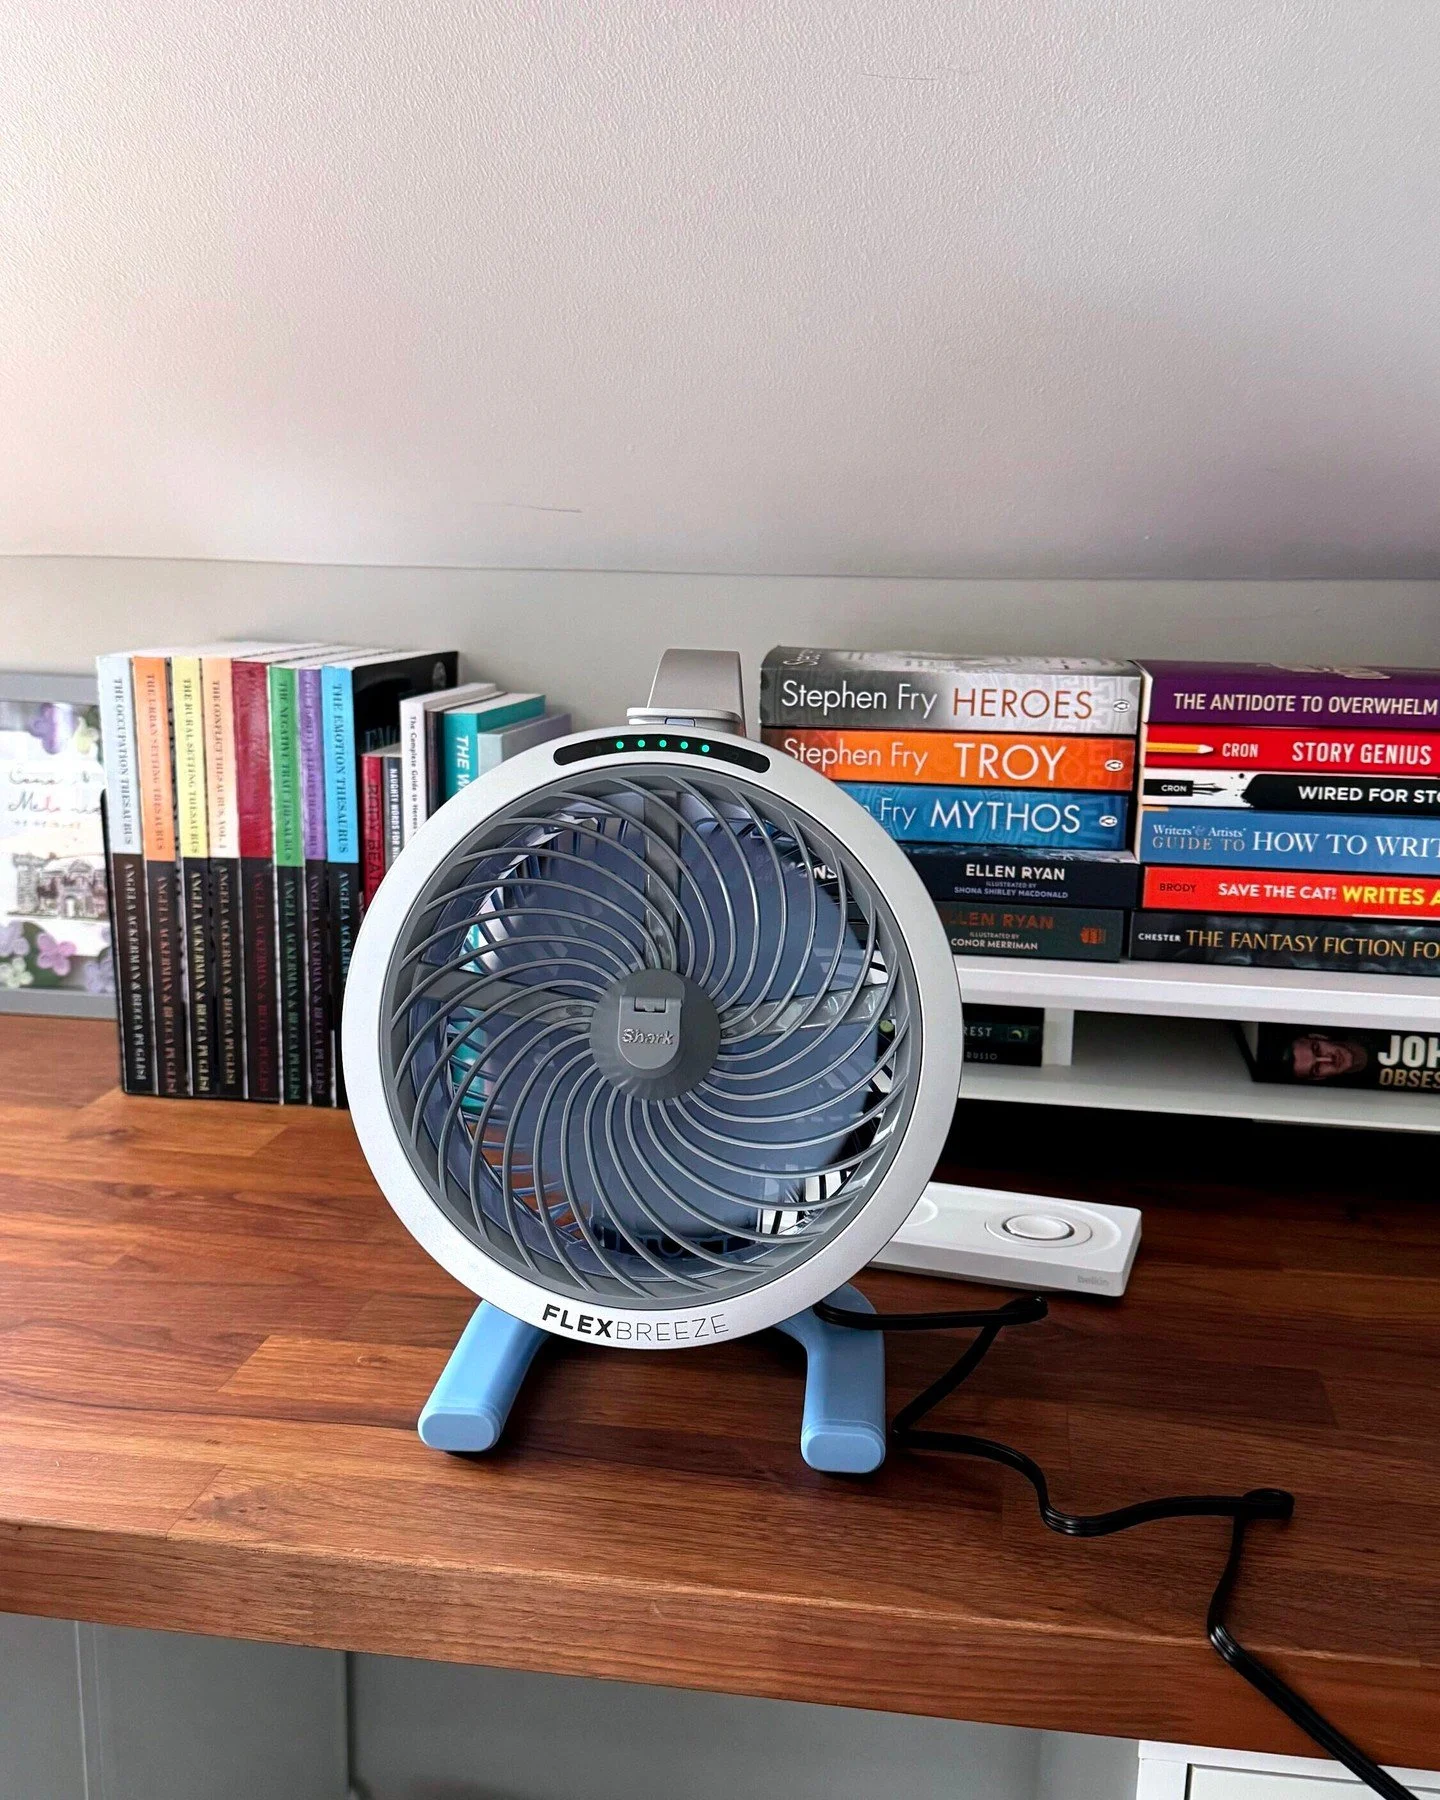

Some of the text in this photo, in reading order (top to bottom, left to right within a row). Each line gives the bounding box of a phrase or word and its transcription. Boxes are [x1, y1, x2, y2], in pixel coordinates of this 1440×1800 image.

[213, 681, 221, 701] THE
[279, 681, 288, 700] THE
[782, 680, 1092, 719] Stephen Fry HEROES
[1174, 693, 1438, 716] THE ANTIDOTE TO OVERWHELM
[214, 704, 223, 754] CONFLICT
[280, 707, 289, 758] NEGATIVE
[114, 678, 133, 845] THE OCCUPATION THESAURUS
[147, 674, 155, 695] THE
[153, 788, 163, 850] THESAURUS
[183, 678, 199, 853] THE RURAL SETTING THESAURUS
[409, 733, 418, 767] Complete
[456, 735, 469, 769] THE
[784, 738, 1067, 781] Stephen Fry TROY
[1222, 742, 1432, 766] CRON STORY GENIUS
[333, 684, 349, 853] THE EMOTION THESAURUS
[390, 768, 398, 802] NAUGHTY
[368, 784, 379, 831] BODY
[1298, 786, 1362, 802] WIRED
[1368, 788, 1407, 802] FOR
[391, 805, 399, 829] WORDS
[880, 798, 1080, 834] Fry MYTHOS
[392, 831, 400, 846] FOR
[1152, 837, 1245, 851] GUIDE TO
[1253, 832, 1319, 852] HOW
[1326, 834, 1367, 854] TO
[124, 863, 137, 911] ANGELA
[219, 866, 230, 913] ANGELA
[966, 864, 1066, 880] ELLEN RYAN
[157, 875, 169, 922] ANGELA
[191, 871, 203, 919] ANGELA
[954, 886, 1068, 898] SHONA SHIRLEY MACDONALD
[1160, 882, 1196, 892] BRODY
[1218, 883, 1260, 897] SAVE
[1264, 885, 1295, 899] THE
[1300, 886, 1336, 900] CAT!
[1342, 886, 1425, 906] WRITES
[339, 871, 351, 984] ANGELA ACKERM
[1002, 913, 1055, 929] RYAN
[127, 915, 140, 979] ACKERMAN
[192, 925, 205, 989] ACKERMAN
[951, 938, 1038, 950] CONOR MERRIMAN
[1138, 932, 1181, 942] CHESTER
[1186, 930, 1224, 948] THE
[1230, 932, 1318, 952] FANTASY
[1324, 936, 1406, 958] FICTION
[132, 993, 143, 1030] BECCA
[196, 1003, 207, 1041] BECCA
[622, 1028, 674, 1044] Shark
[542, 1303, 729, 1341] FLEXBREEZE
